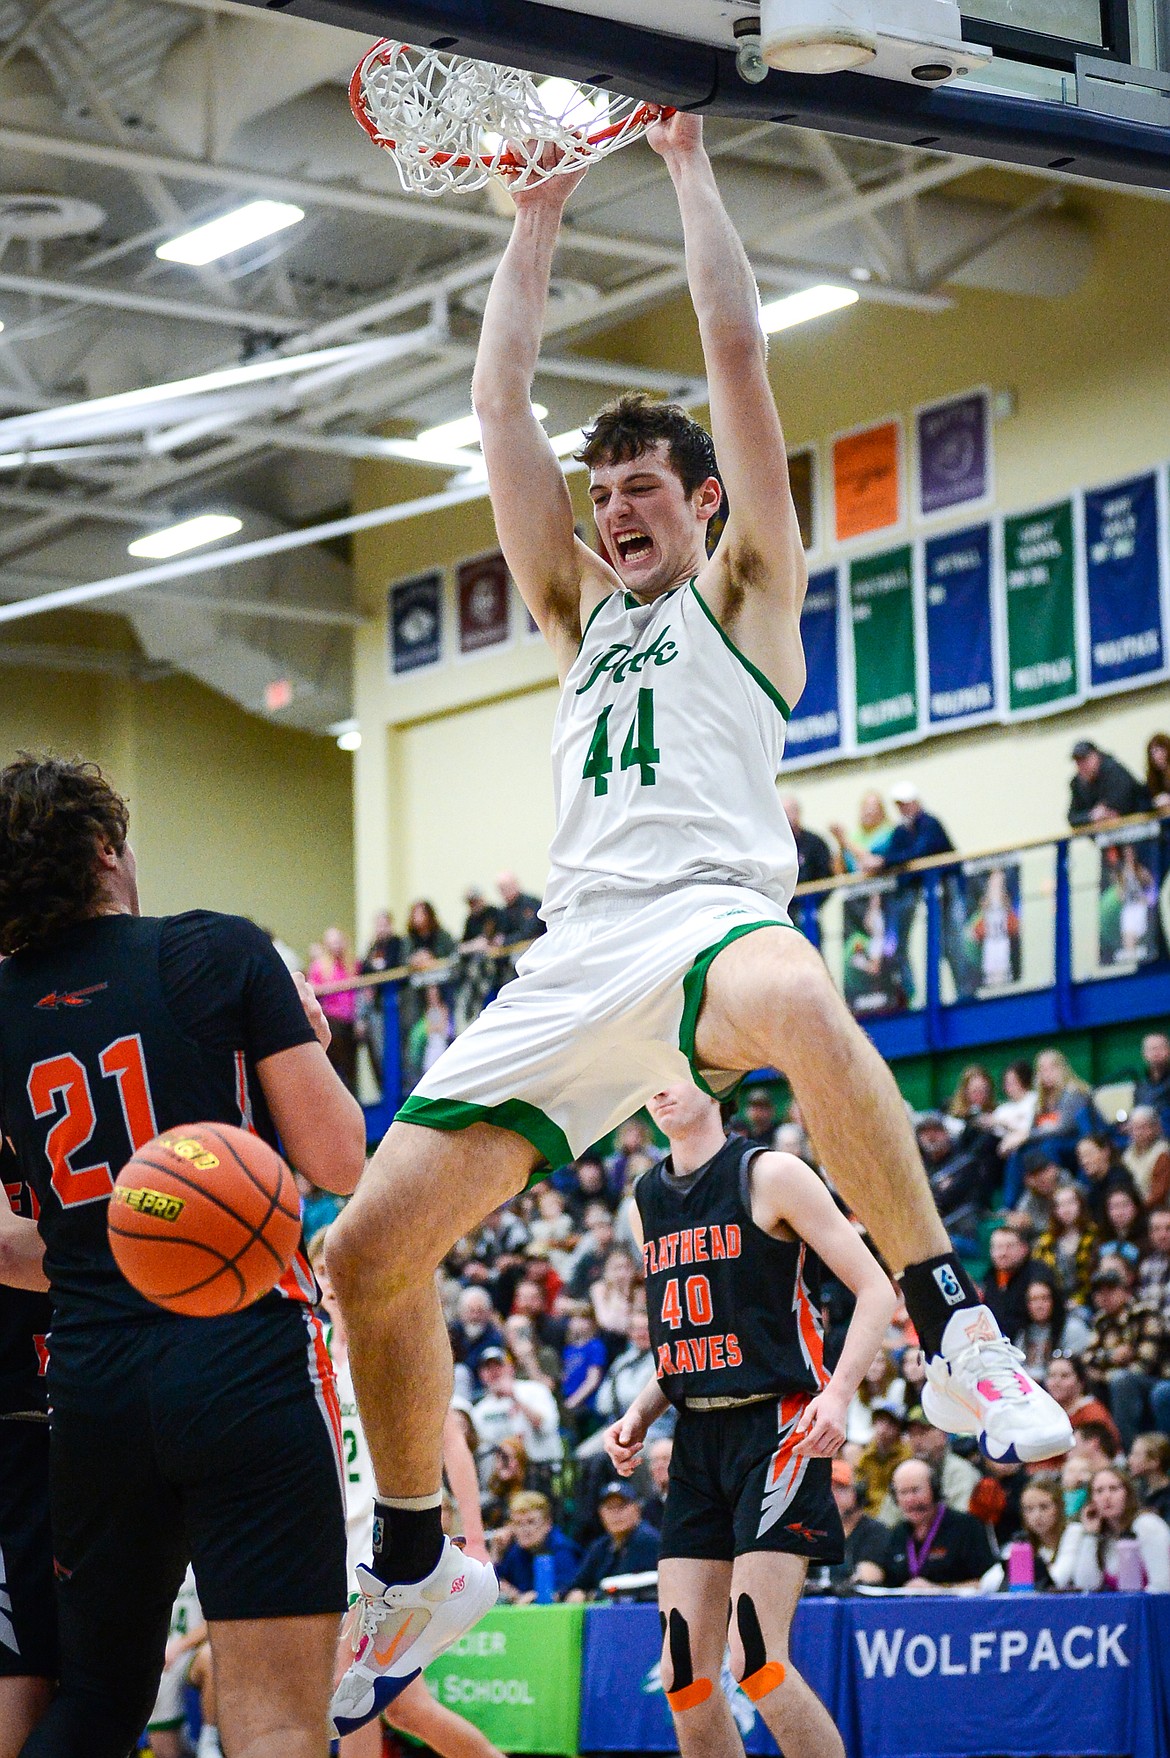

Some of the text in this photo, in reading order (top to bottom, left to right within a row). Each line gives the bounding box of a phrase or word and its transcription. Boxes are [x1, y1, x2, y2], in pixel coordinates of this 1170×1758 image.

[582, 687, 660, 797] 44
[27, 1033, 159, 1209] 21
[141, 1190, 184, 1221] PRO
[643, 1224, 742, 1278] FLATHEAD
[661, 1274, 714, 1330] 40
[855, 1623, 1130, 1679] WOLFPACK
[444, 1674, 535, 1705] SCHOOL
